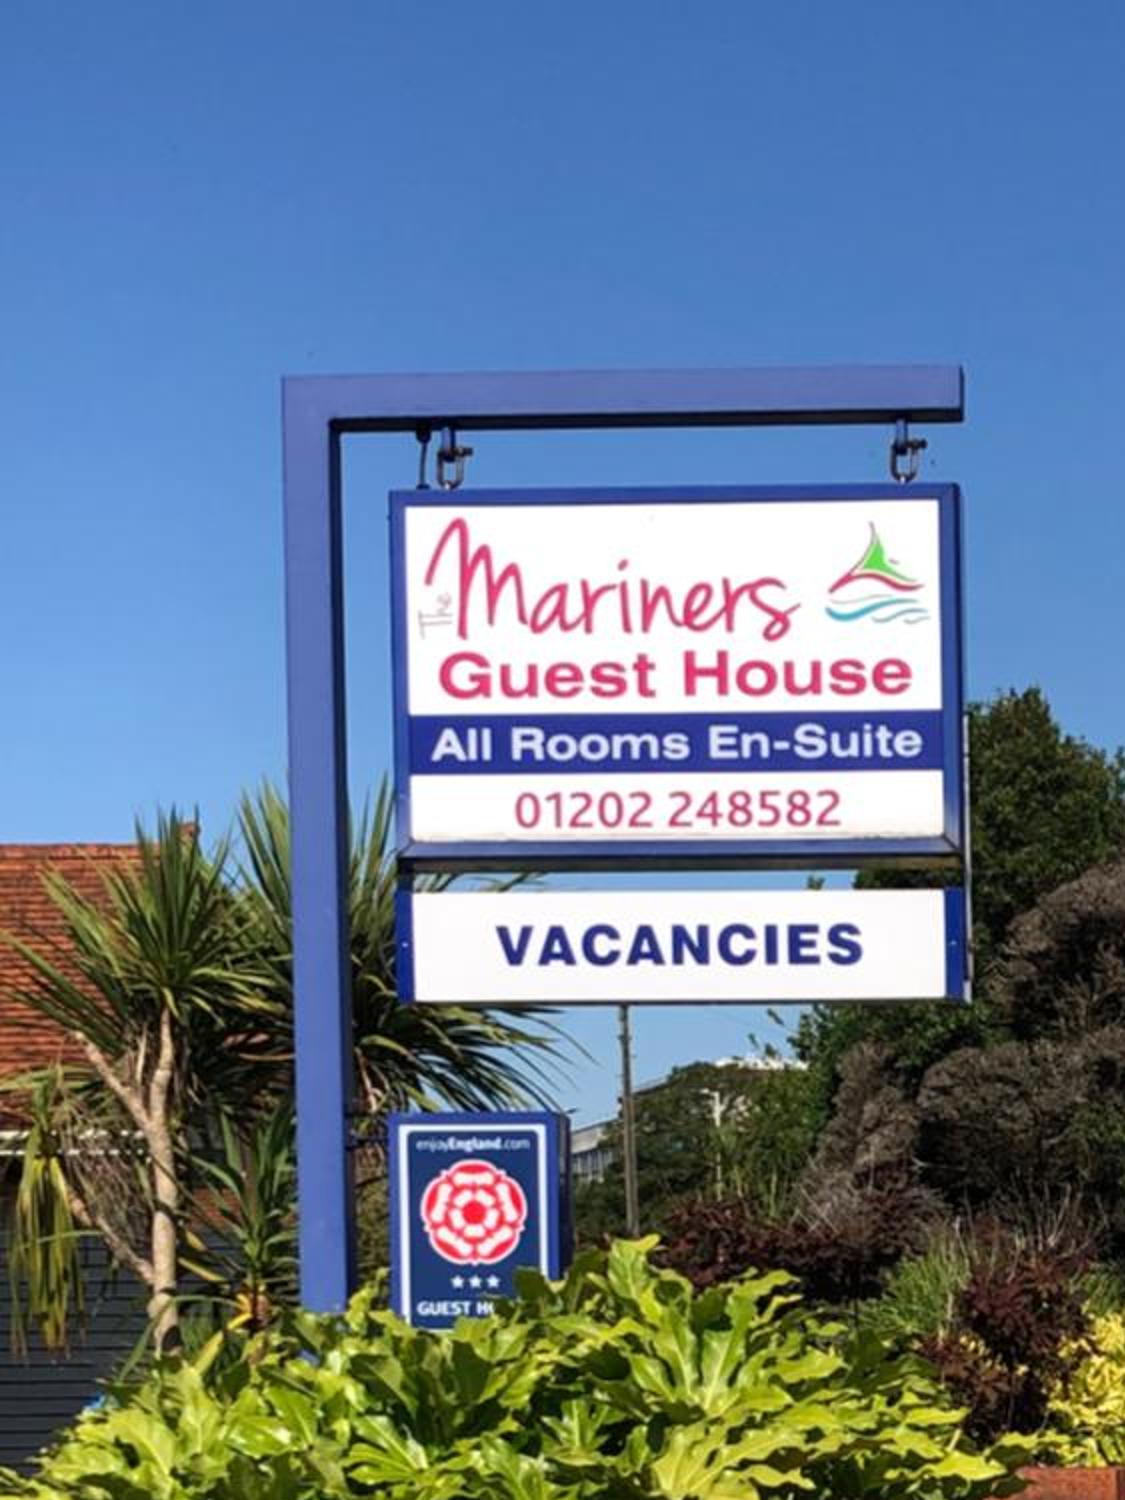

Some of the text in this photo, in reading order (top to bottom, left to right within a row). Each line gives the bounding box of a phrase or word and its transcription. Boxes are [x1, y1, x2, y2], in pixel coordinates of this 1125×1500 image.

[417, 517, 801, 642] The Mariners
[438, 650, 912, 699] Guest House
[431, 723, 923, 762] All Rooms En-Suite
[515, 789, 842, 829] 01202 248582
[496, 923, 863, 967] VACANCIES
[416, 1137, 530, 1153] enjoyEngland.com
[416, 1300, 472, 1317] GUEST
